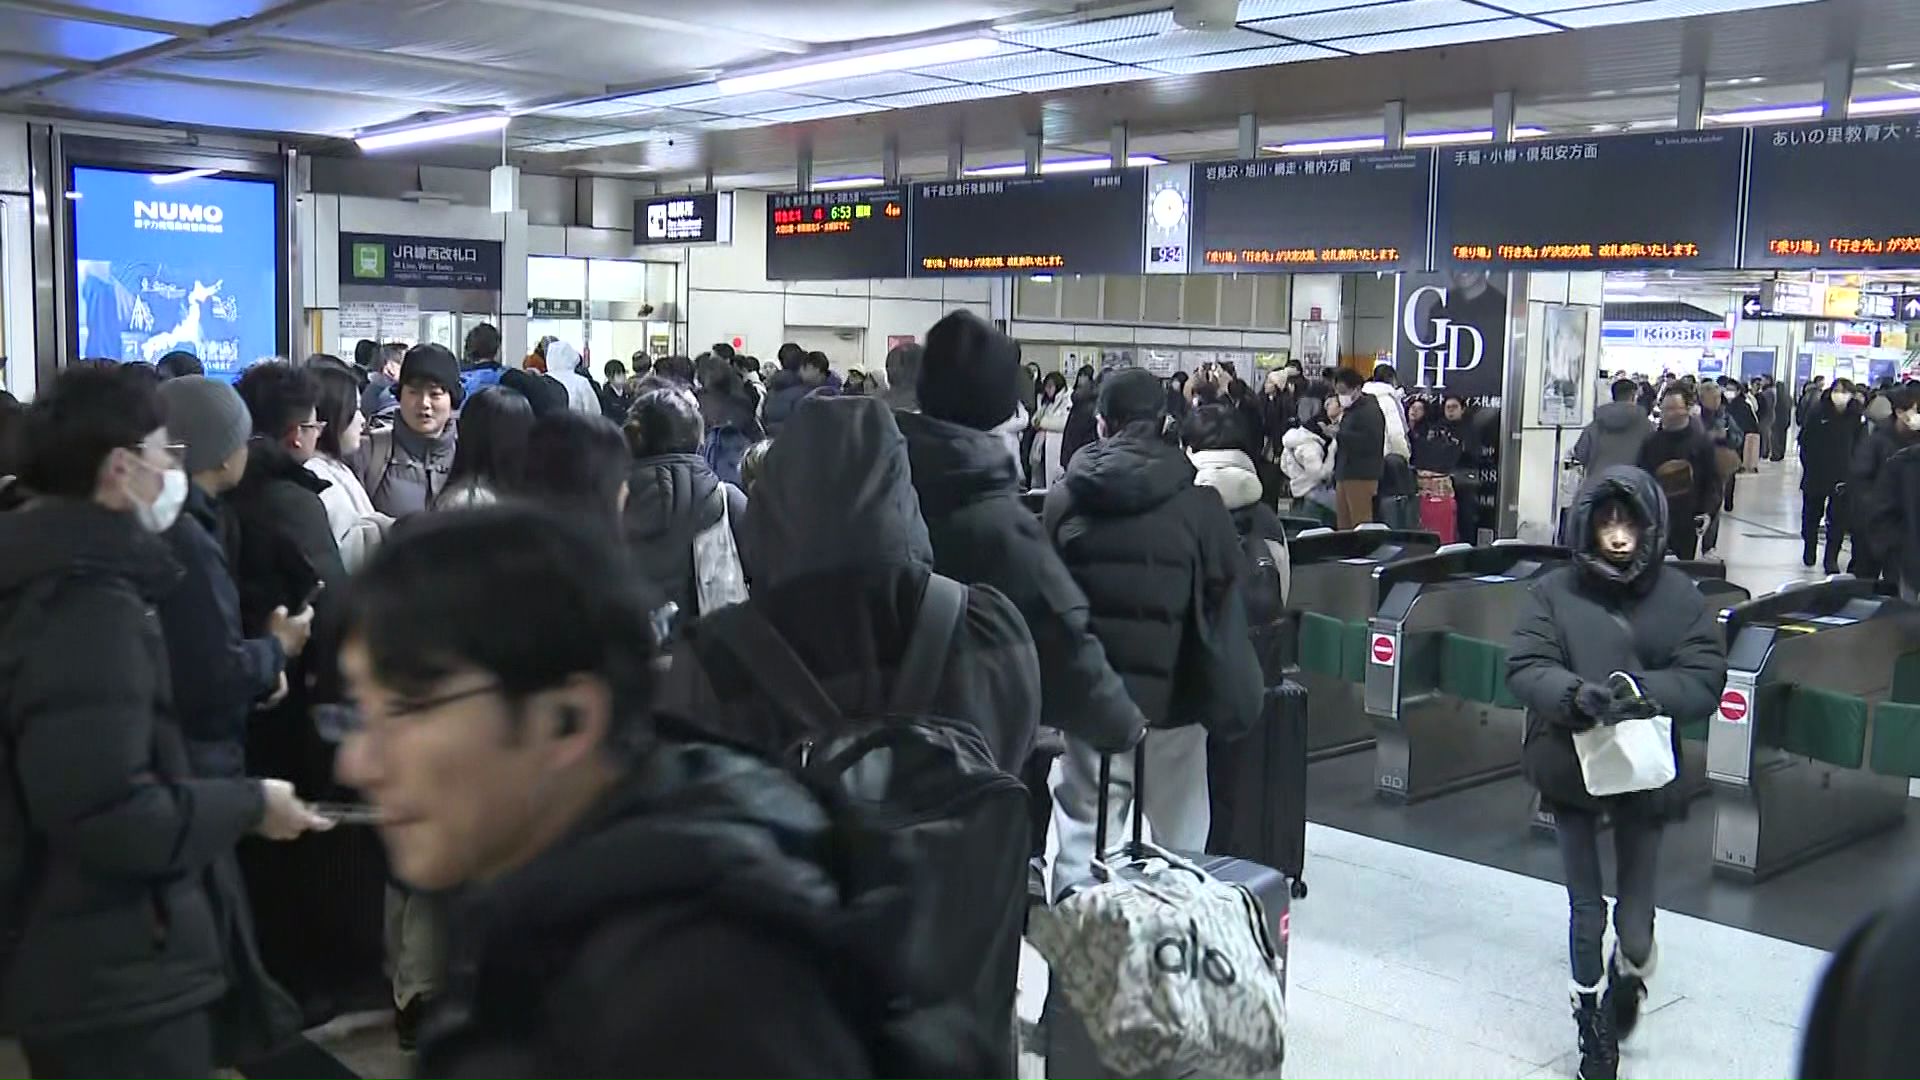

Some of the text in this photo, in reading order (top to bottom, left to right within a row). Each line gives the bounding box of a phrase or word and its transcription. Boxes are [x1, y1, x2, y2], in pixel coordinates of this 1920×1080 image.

[133, 200, 223, 223] NUMO
[831, 206, 852, 219] 6:53
[1644, 326, 1705, 340] Kiosk
[1154, 916, 1236, 986] alo
